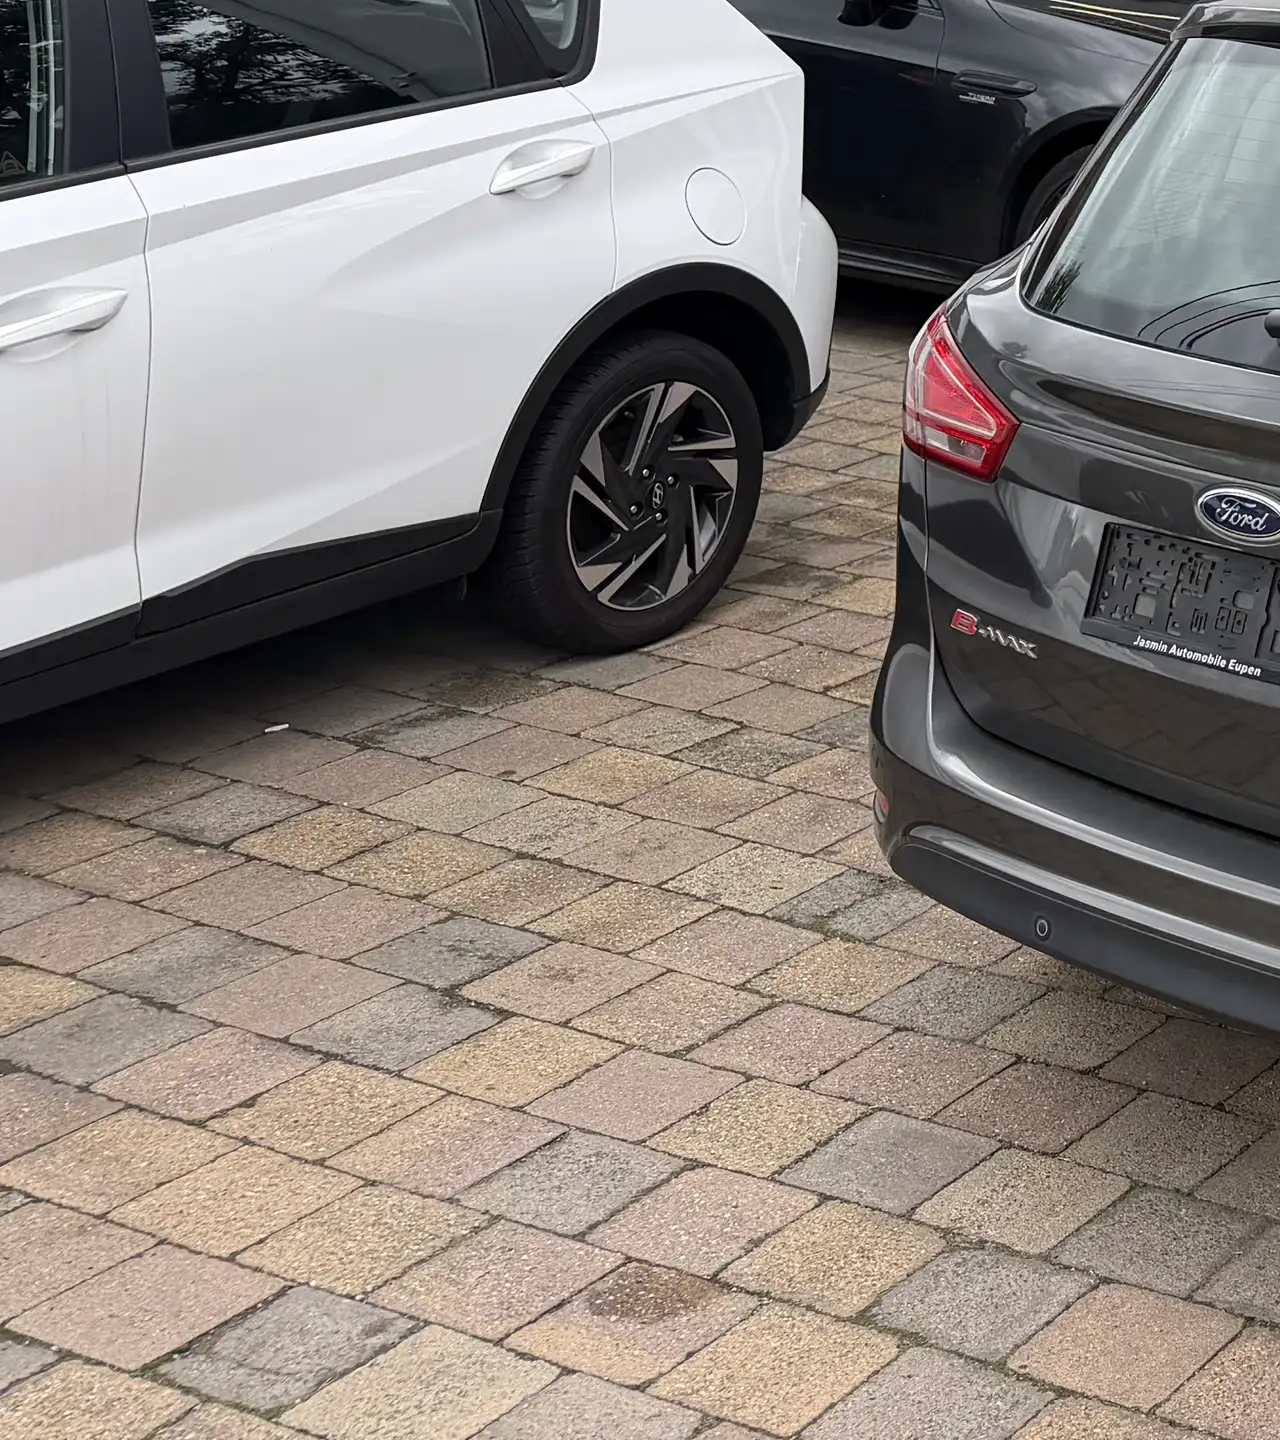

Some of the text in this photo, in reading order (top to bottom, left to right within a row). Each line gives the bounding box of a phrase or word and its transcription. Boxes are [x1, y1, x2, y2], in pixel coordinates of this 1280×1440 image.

[1215, 497, 1268, 533] Ford
[1133, 635, 1168, 654] Jasmin
[1169, 644, 1227, 669] Automobile
[1228, 658, 1262, 678] Eupen
